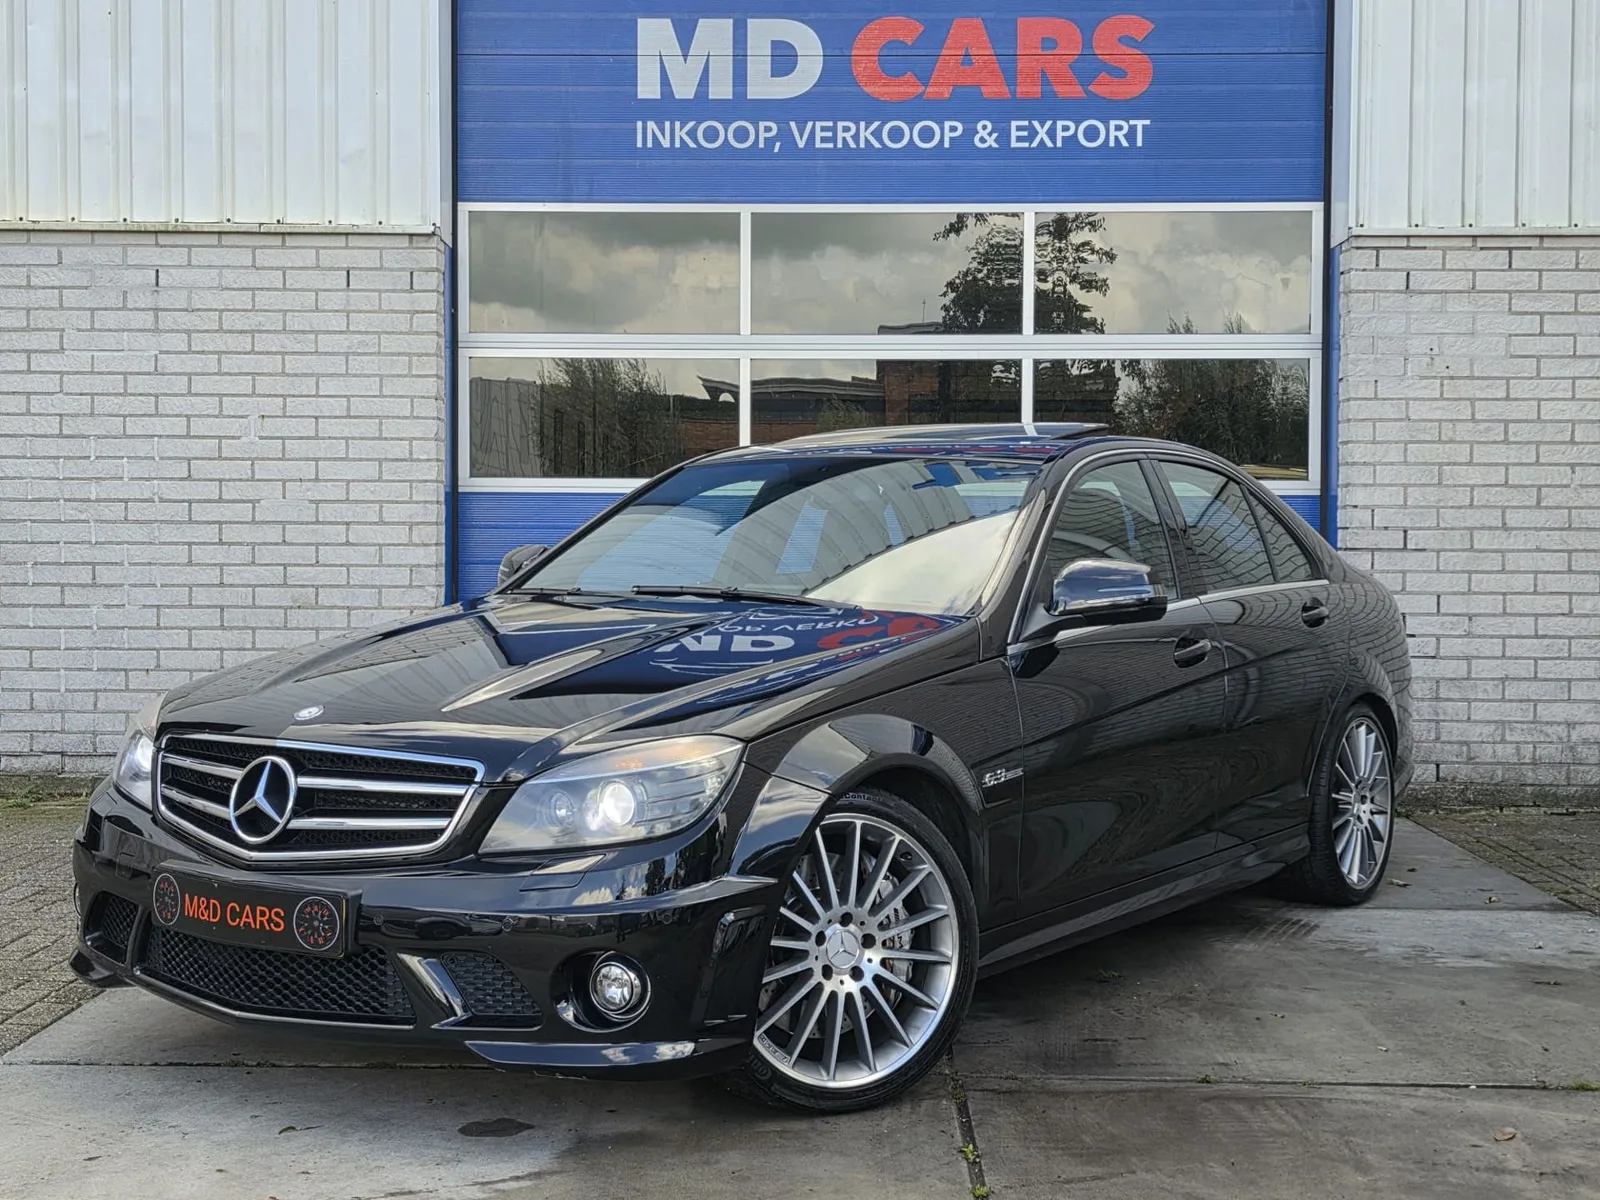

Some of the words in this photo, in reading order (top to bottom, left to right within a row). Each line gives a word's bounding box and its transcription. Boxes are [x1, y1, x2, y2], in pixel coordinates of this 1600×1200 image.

[636, 18, 823, 100] MD
[851, 15, 1156, 102] CARS
[636, 120, 781, 153] INKOOP,
[789, 120, 964, 149] VERKOOP
[973, 119, 999, 148] &
[1010, 119, 1151, 148] EXPORT
[184, 893, 221, 923] M&D
[226, 902, 285, 932] CARS
